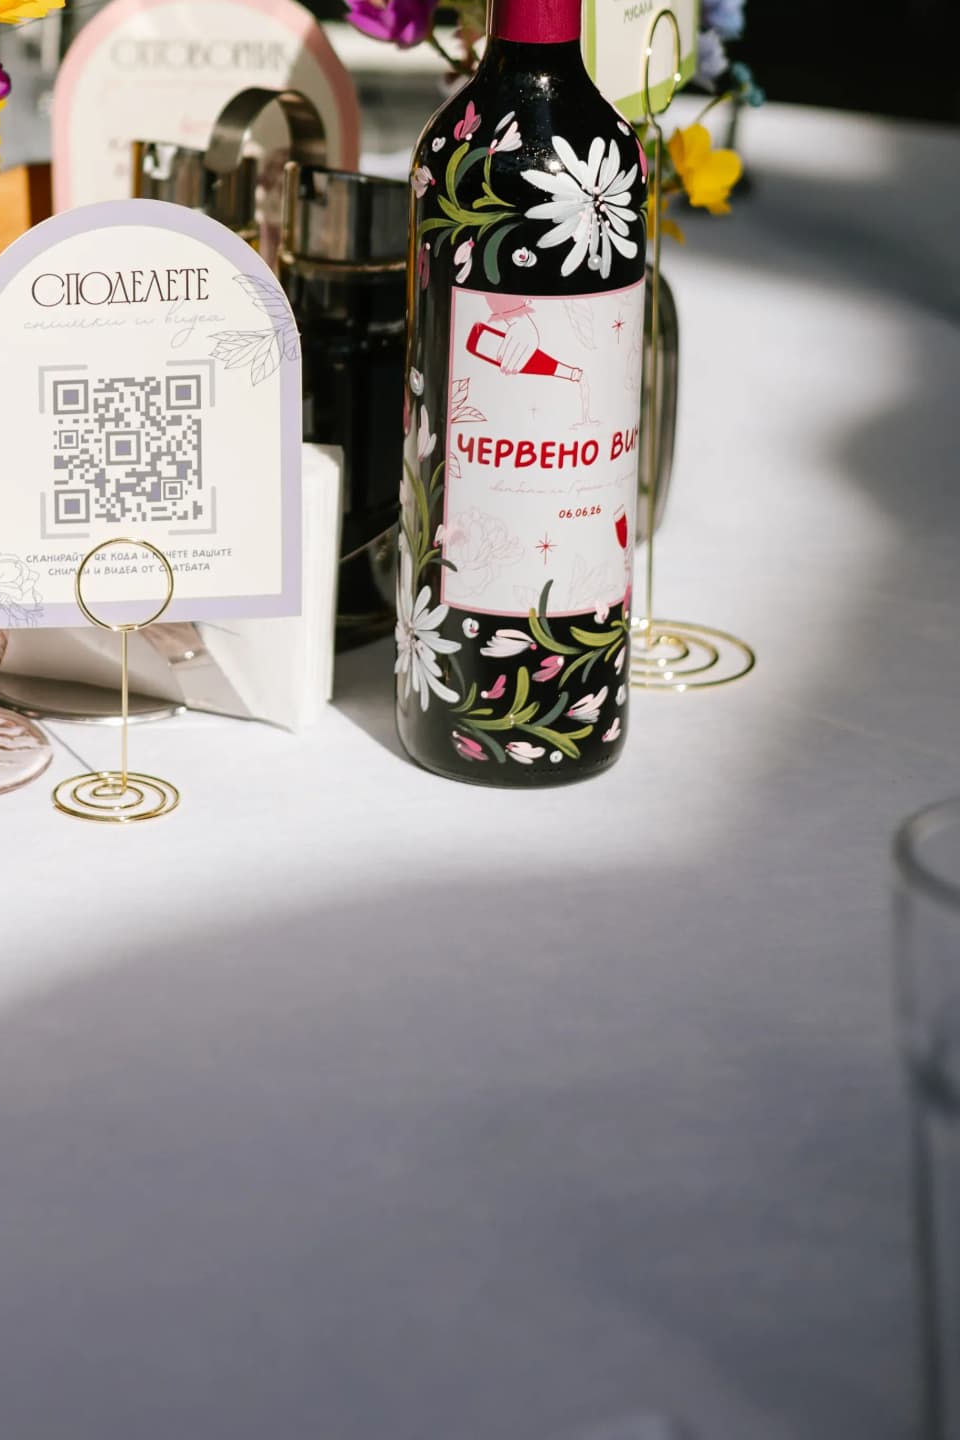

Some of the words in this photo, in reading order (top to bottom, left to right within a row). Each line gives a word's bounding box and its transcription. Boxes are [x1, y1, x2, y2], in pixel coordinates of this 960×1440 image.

[31, 268, 209, 307] СПОДЕЛЕТЕ
[457, 433, 600, 470] ЧЕРВЕНО
[26, 552, 87, 563] СКАНИРАЙТ
[94, 552, 106, 561] QR
[111, 552, 138, 561] КОДА
[152, 549, 188, 559] ЧЕТЕ
[192, 548, 232, 558] ВАШИТЕ
[48, 567, 90, 576] СНИМИ
[141, 565, 154, 573] ОТ
[158, 562, 211, 572] САТБАТА
